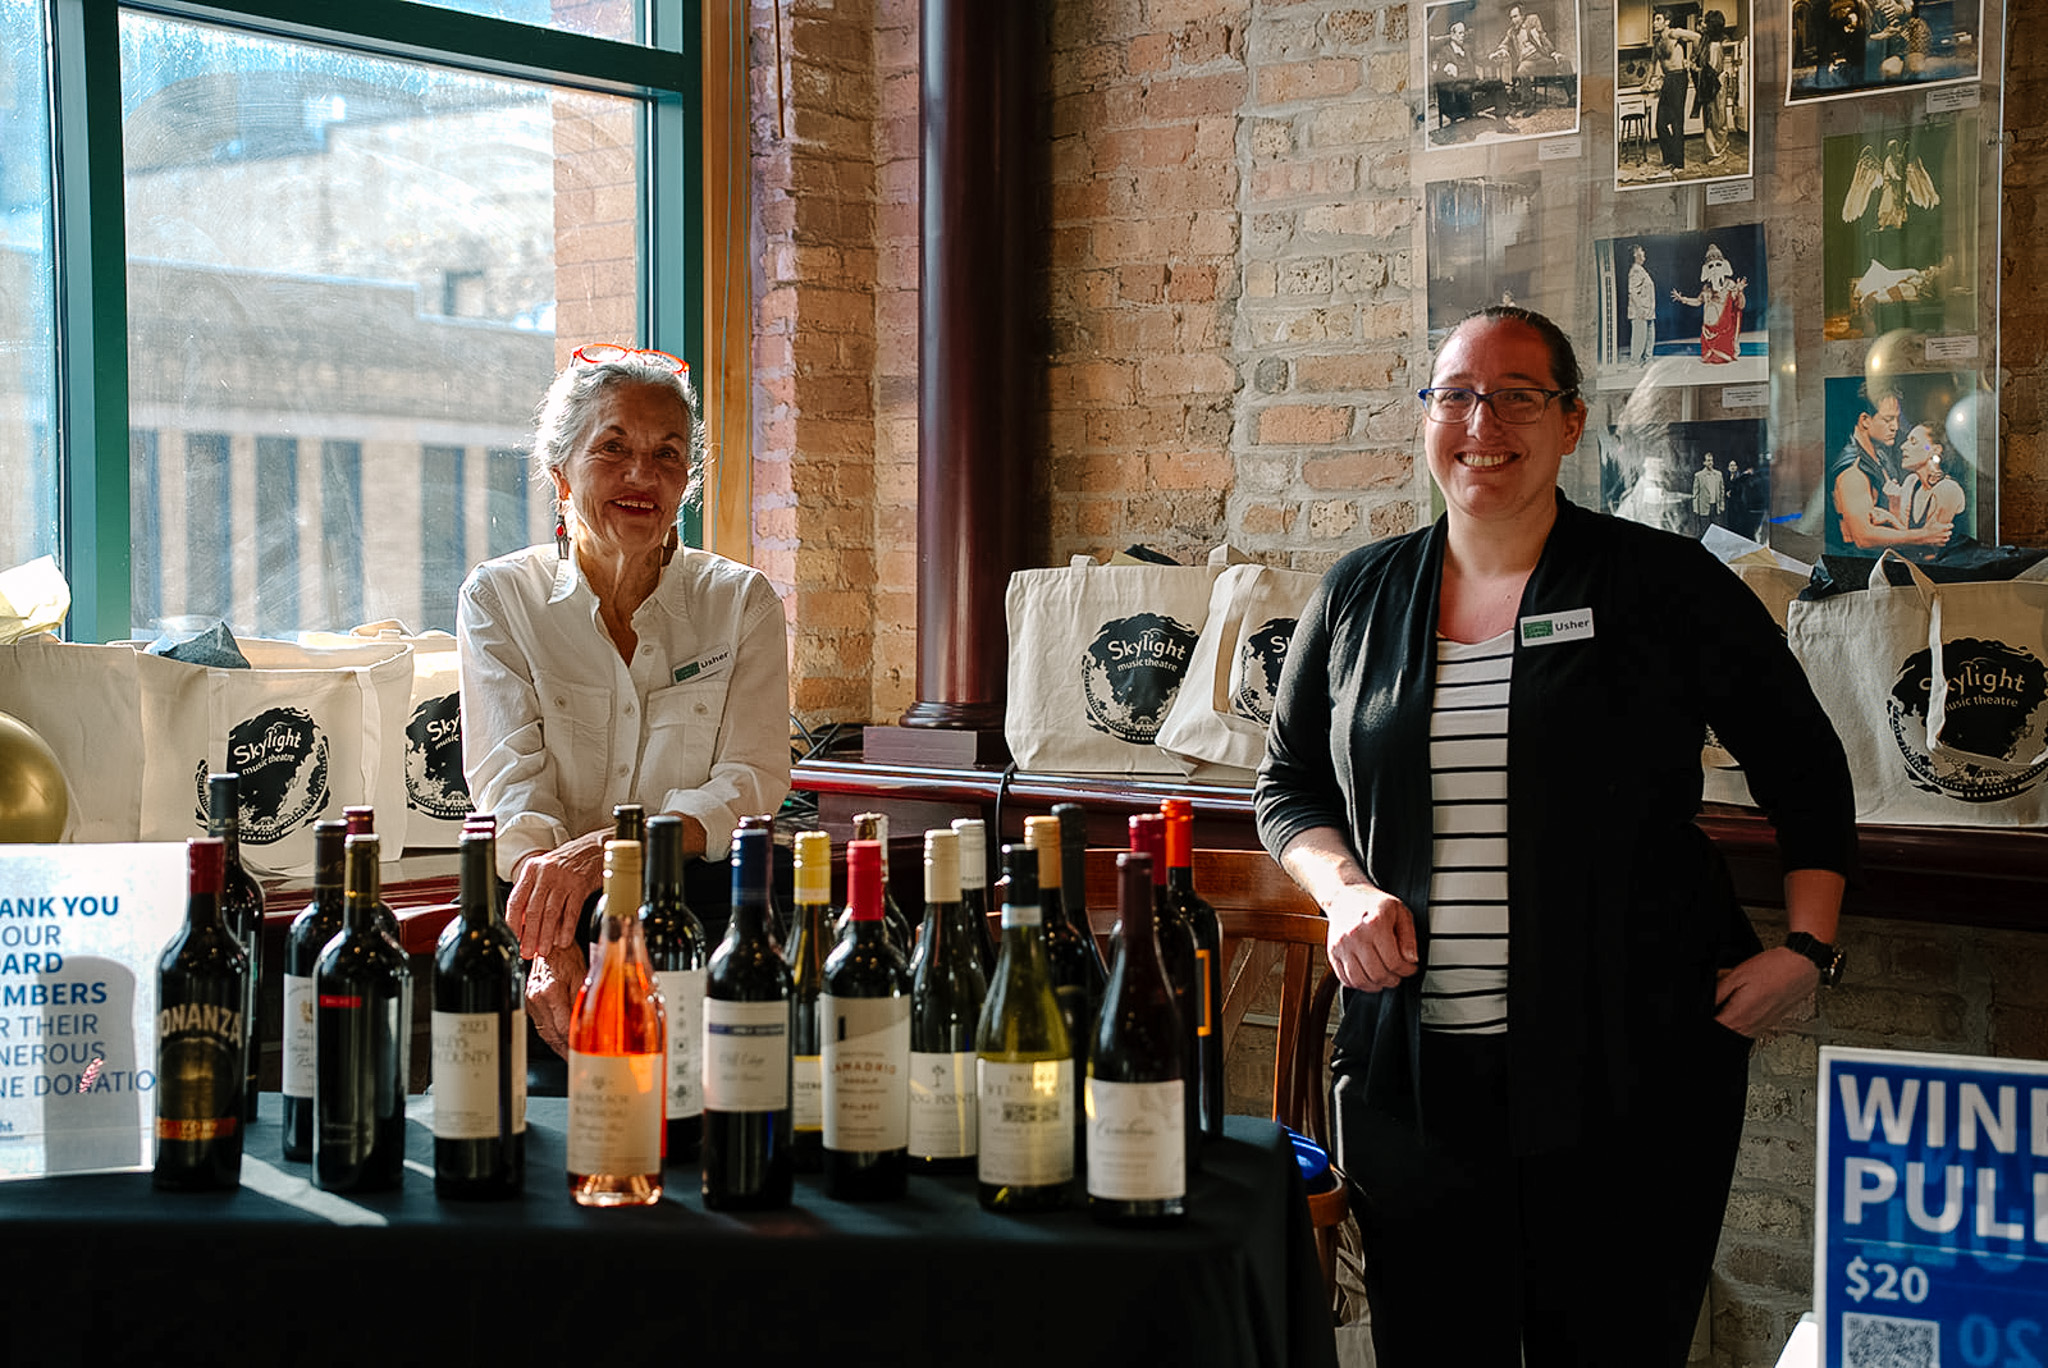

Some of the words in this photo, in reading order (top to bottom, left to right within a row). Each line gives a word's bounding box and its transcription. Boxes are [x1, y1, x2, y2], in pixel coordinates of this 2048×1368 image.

[1555, 620, 1590, 632] Usher
[1107, 633, 1186, 660] Skylight
[700, 651, 728, 668] Usher
[1117, 659, 1144, 672] music
[1144, 657, 1178, 672] theatre
[1945, 696, 1971, 711] usic
[1973, 694, 2019, 707] theatre
[233, 727, 302, 764] Skylight
[242, 758, 268, 775] music
[268, 753, 295, 763] theatre
[61, 895, 119, 917] YOU
[2, 924, 62, 947] OUR
[1, 952, 64, 975] ARD
[18, 1013, 99, 1037] THEIR
[1845, 1255, 1929, 1303] $20
